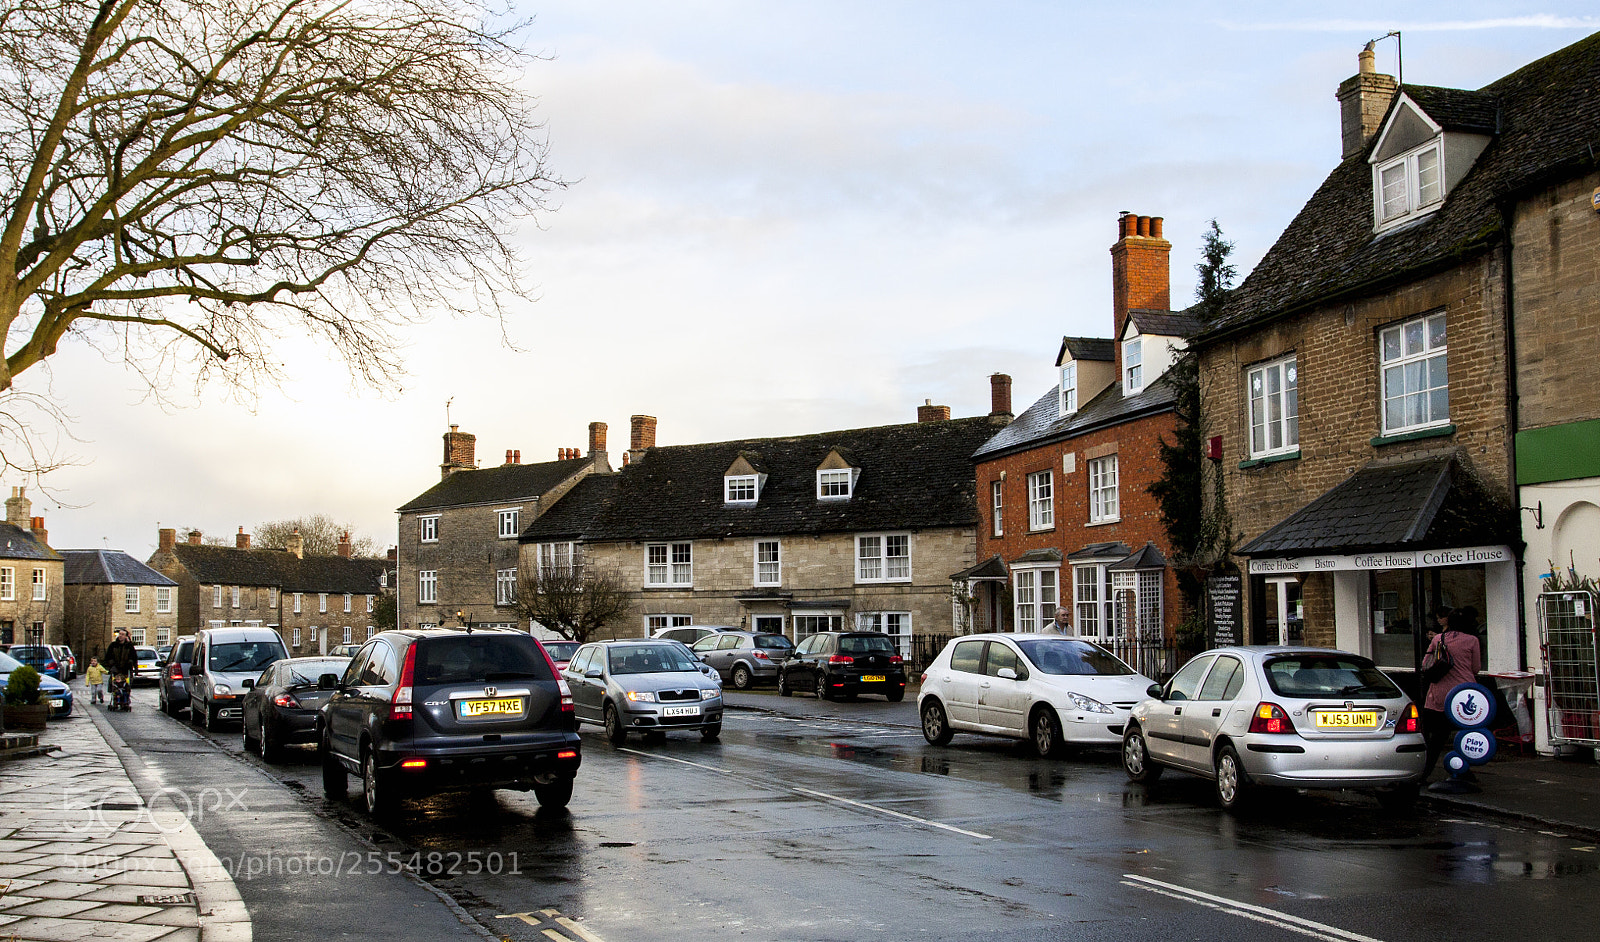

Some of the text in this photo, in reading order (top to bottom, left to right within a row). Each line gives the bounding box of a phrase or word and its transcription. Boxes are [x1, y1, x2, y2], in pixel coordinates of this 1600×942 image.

[1354, 555, 1412, 568] Coffee House
[1423, 549, 1503, 564] Coffee House
[1251, 560, 1299, 572] Coffee House
[1314, 558, 1336, 569] Bistro
[468, 700, 520, 713] YF57 HXE
[1322, 714, 1372, 725] WJ53 UNH
[1466, 738, 1484, 747] Play
[1464, 744, 1484, 753] here
